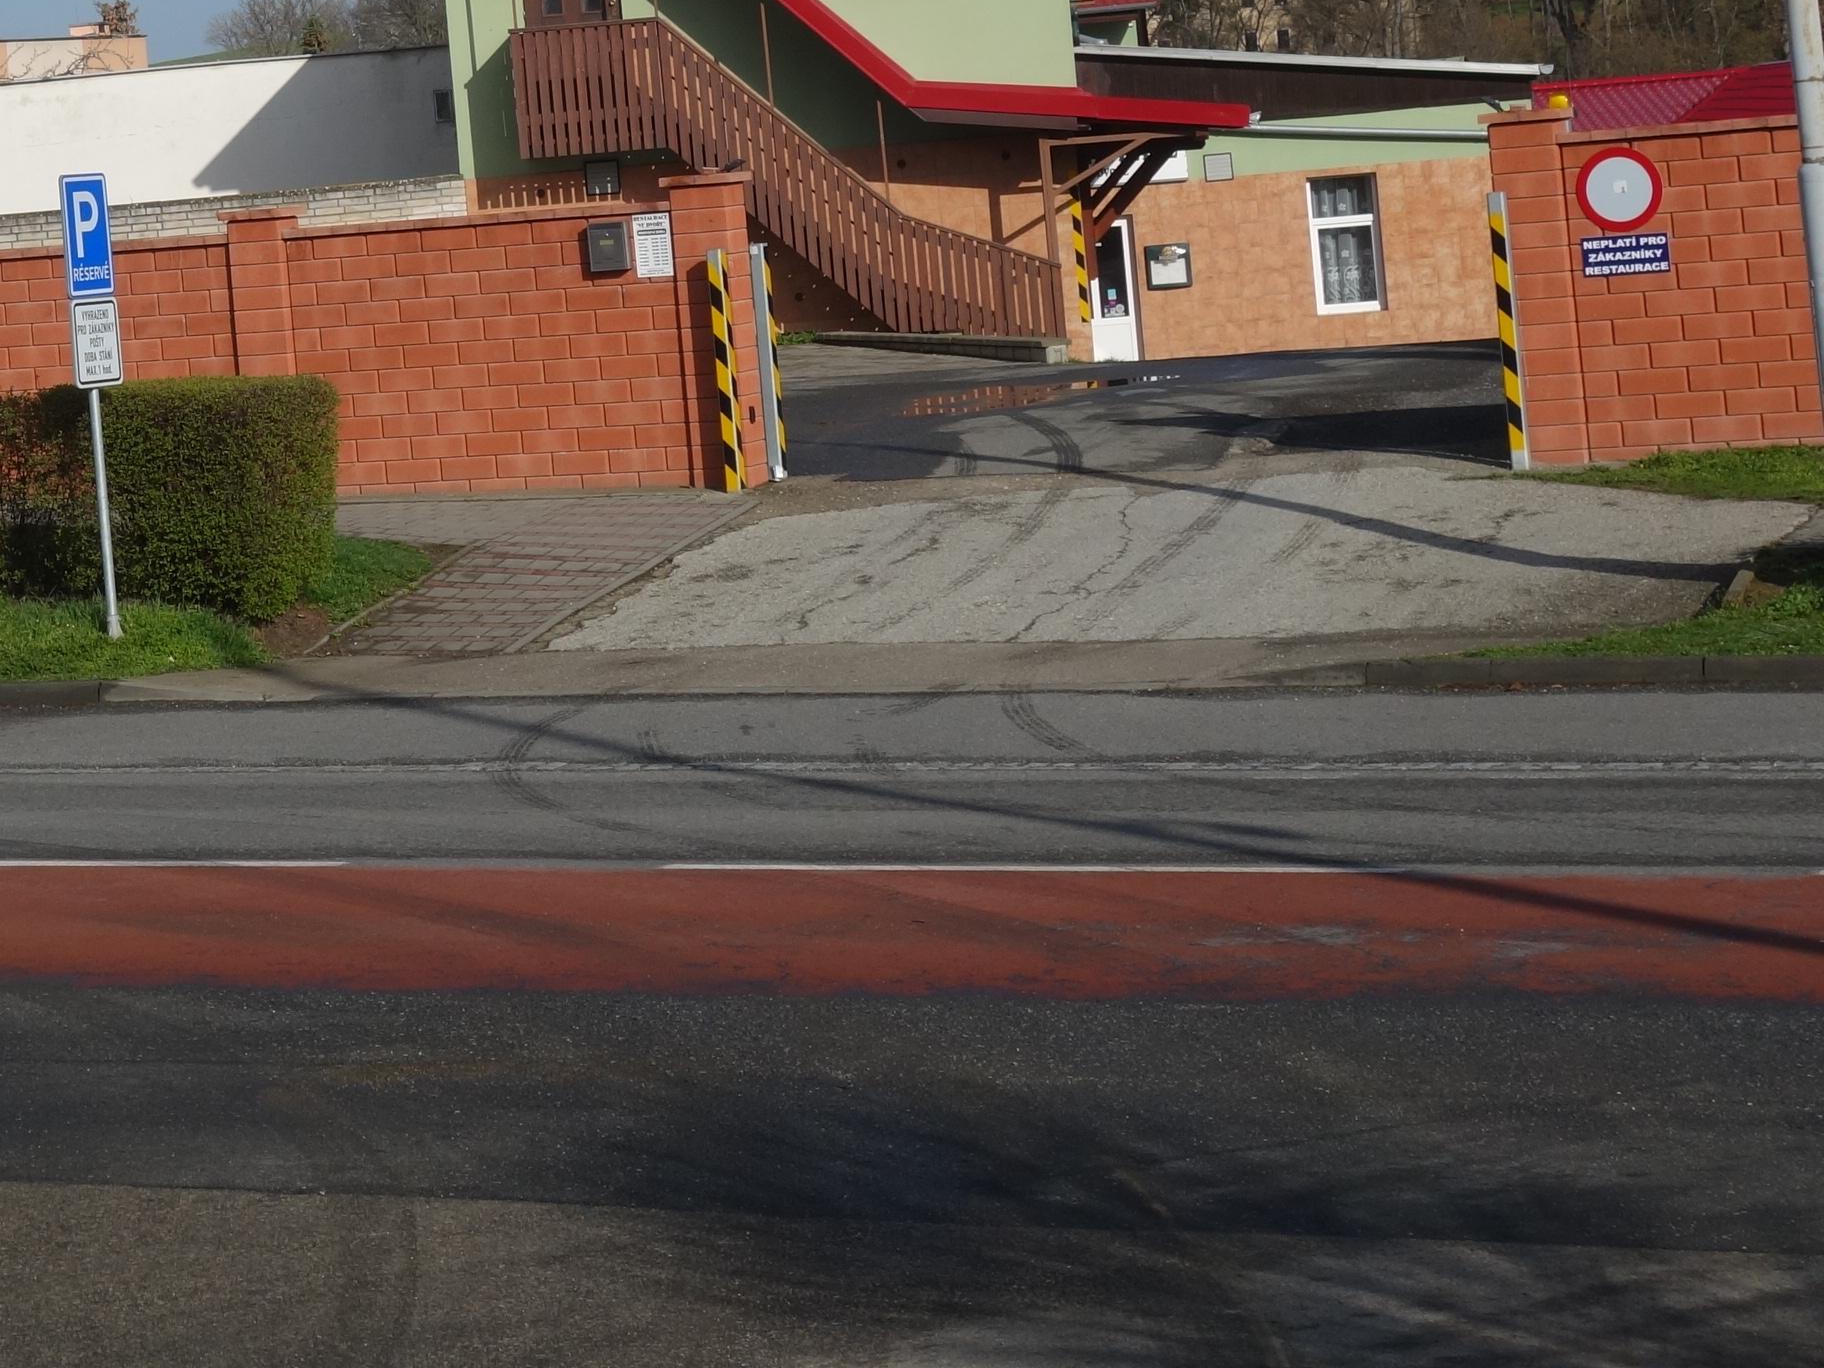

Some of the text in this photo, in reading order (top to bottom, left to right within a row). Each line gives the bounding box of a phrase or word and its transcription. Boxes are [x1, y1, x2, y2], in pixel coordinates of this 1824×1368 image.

[72, 191, 98, 258] P
[1583, 235, 1666, 250] NEPLATÍ PRO
[1588, 248, 1663, 263] ZÁKAZNÍKY
[73, 261, 110, 282] RÉSERVÉ
[1585, 262, 1669, 276] RESTAURACE
